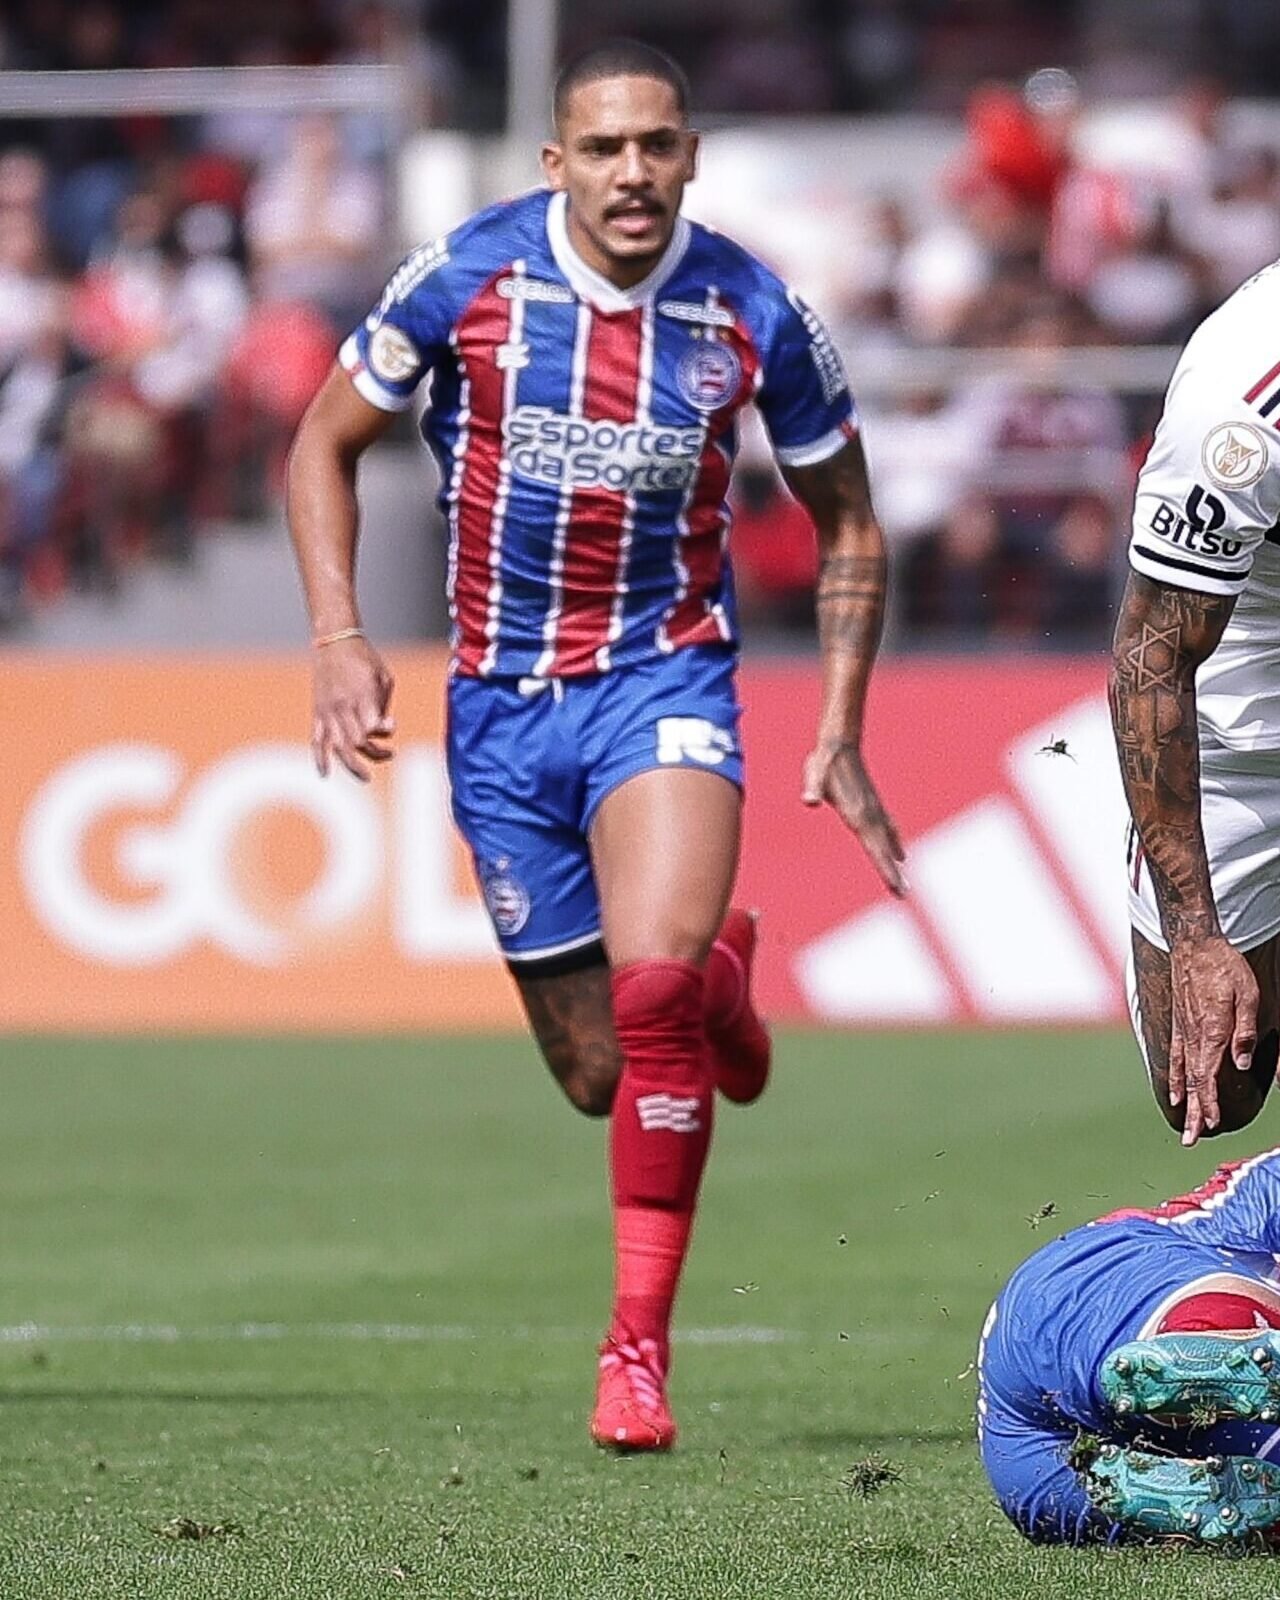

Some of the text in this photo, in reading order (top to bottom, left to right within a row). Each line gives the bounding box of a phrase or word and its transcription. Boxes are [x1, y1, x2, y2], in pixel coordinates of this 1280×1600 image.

[508, 410, 702, 459] Esportes
[514, 450, 565, 480] da
[1149, 502, 1242, 557] Bitso
[20, 742, 503, 968] GOL
